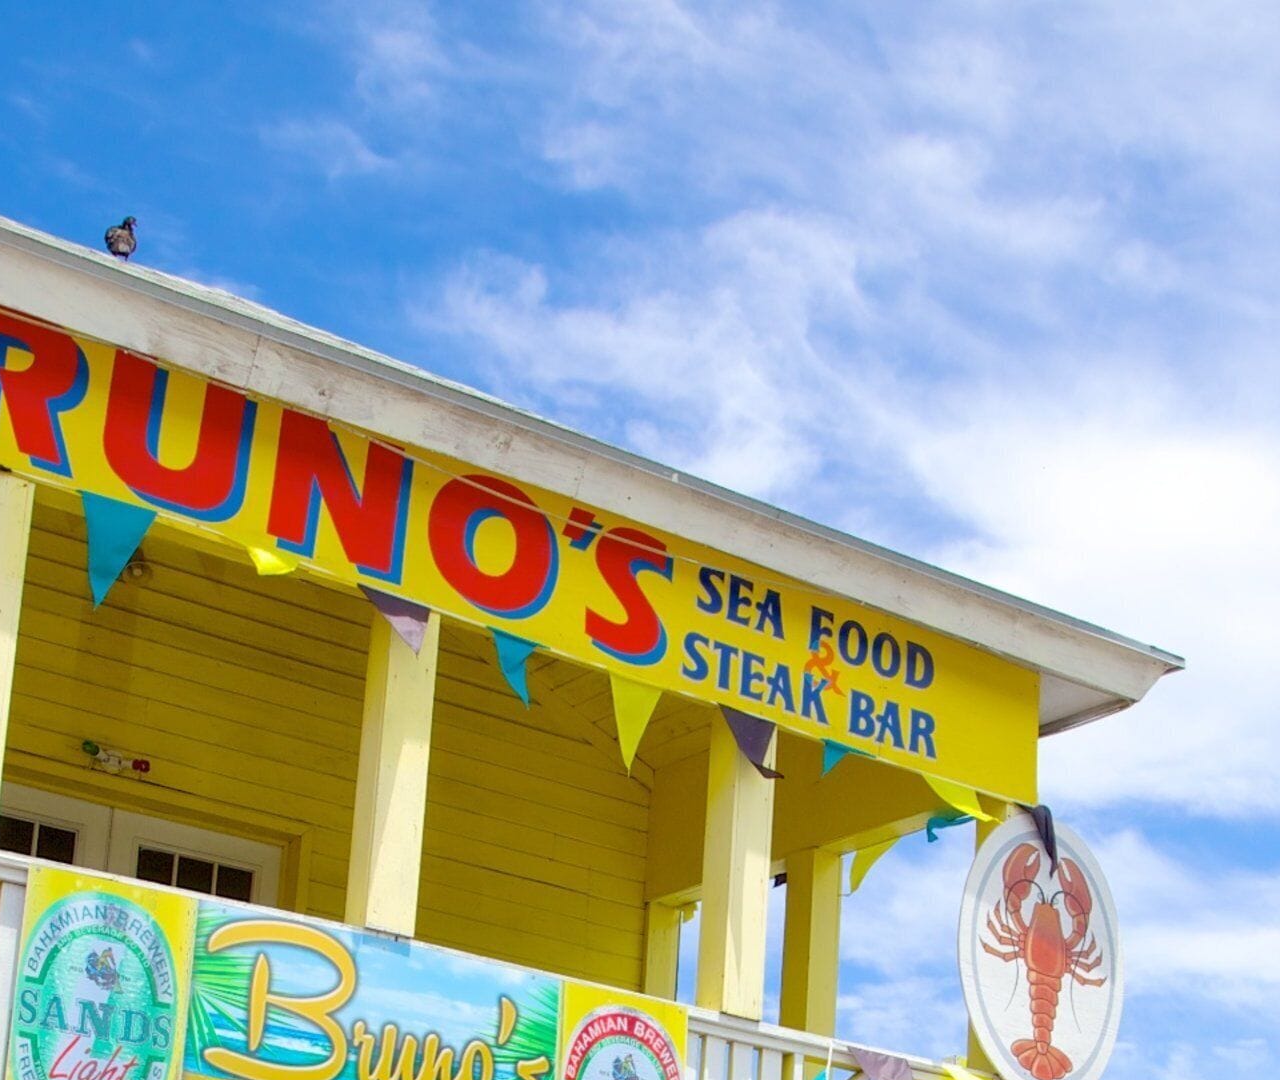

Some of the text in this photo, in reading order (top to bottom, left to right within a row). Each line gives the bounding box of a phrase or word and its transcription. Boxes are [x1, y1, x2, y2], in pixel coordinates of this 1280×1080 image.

[696, 566, 935, 690] SEA FOOD
[681, 631, 938, 760] STEAK BAR
[804, 640, 846, 698] &
[27, 904, 173, 997] BAHAMIAN BREWERY
[19, 989, 173, 1050] SANDS
[566, 1016, 629, 1079] BAHAMIAN
